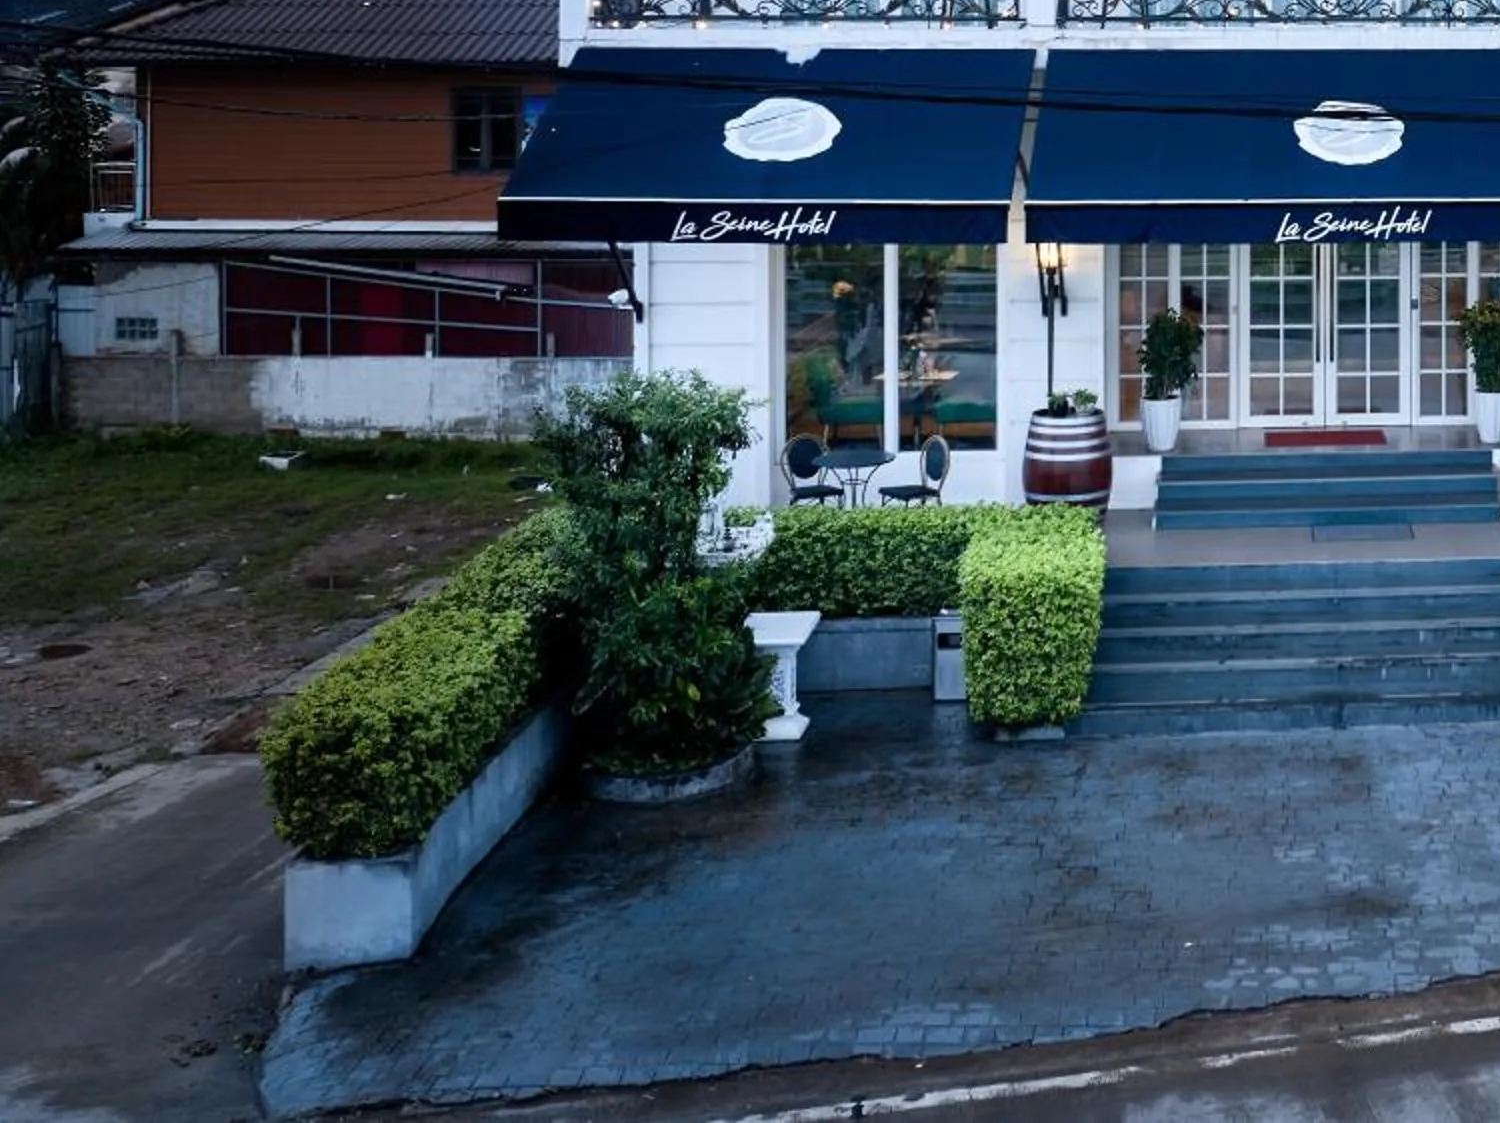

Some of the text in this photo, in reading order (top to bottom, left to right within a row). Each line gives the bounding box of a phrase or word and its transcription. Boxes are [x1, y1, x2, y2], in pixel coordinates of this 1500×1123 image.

[670, 206, 837, 242] La Seine Hotel
[1275, 205, 1433, 243] La Seine Hotel
